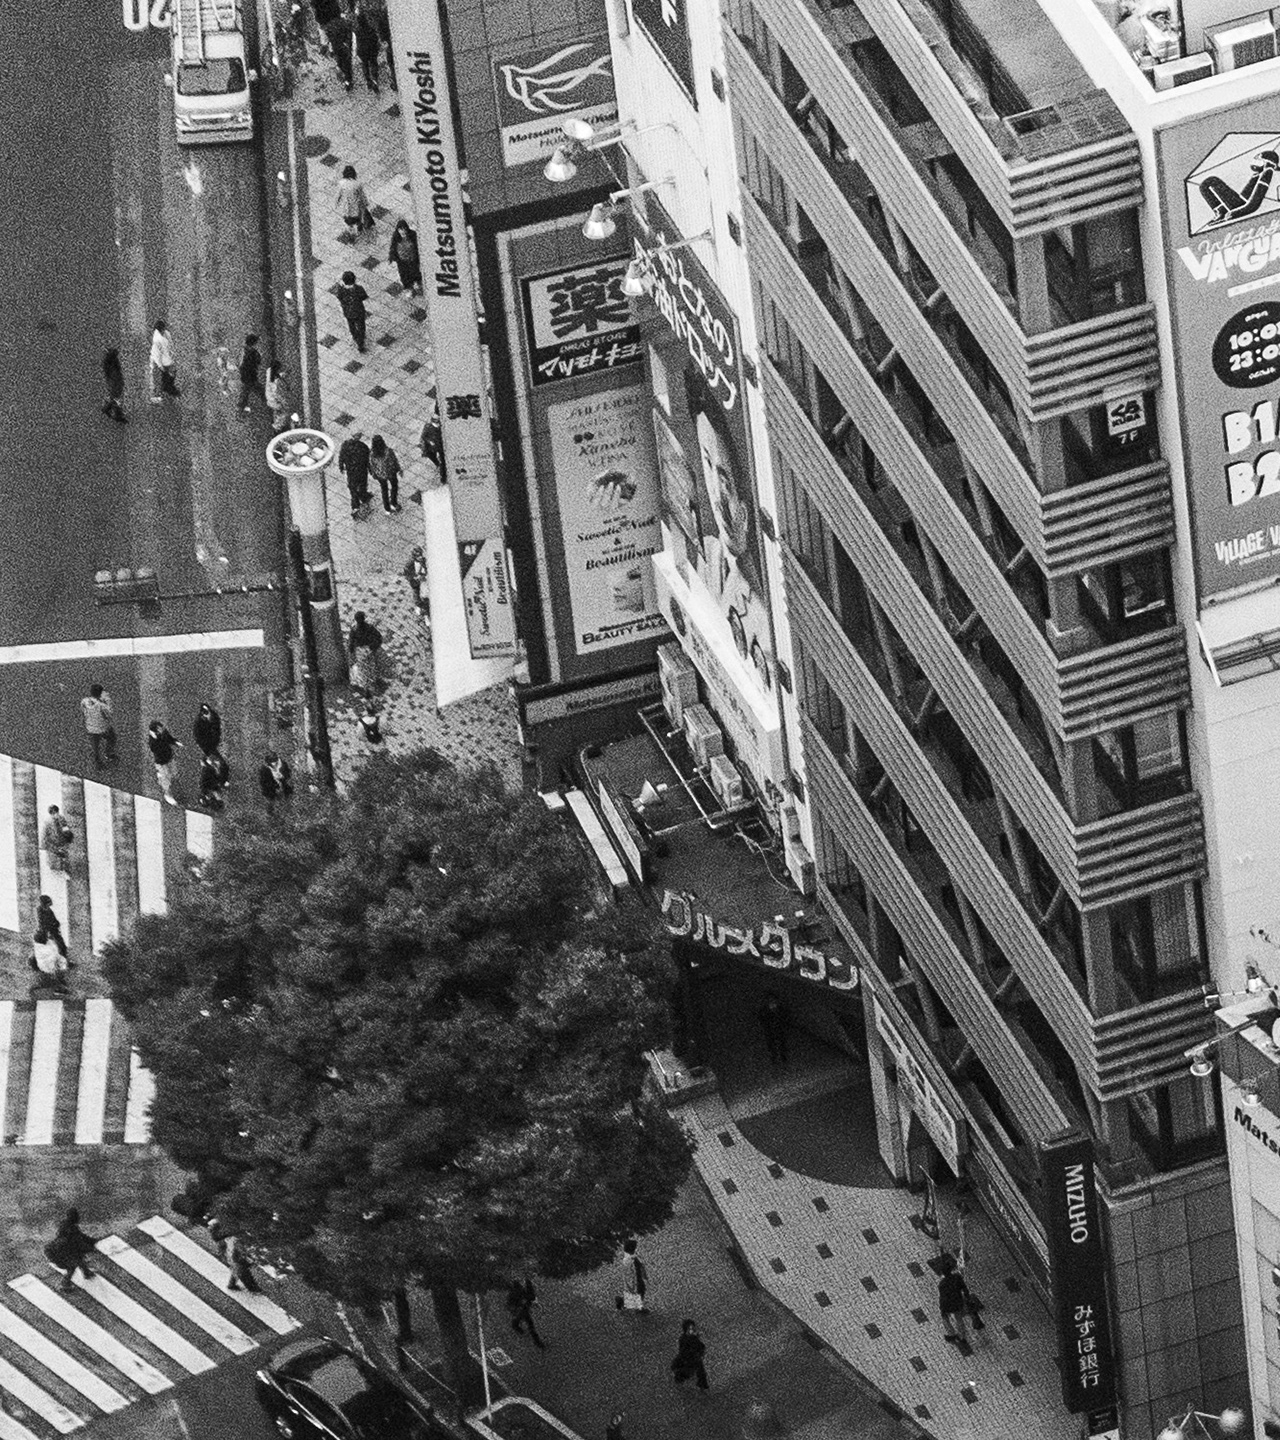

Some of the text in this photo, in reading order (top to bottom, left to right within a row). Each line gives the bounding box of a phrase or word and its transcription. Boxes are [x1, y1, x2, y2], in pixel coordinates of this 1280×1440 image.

[406, 51, 461, 298] Matsumoto KiYoshi
[547, 266, 633, 339] 薬
[582, 624, 633, 645] BEAUTY
[635, 617, 668, 633] SALO
[1064, 1163, 1088, 1244] MIZUHO
[1074, 1305, 1100, 1388] みずほ銀行
